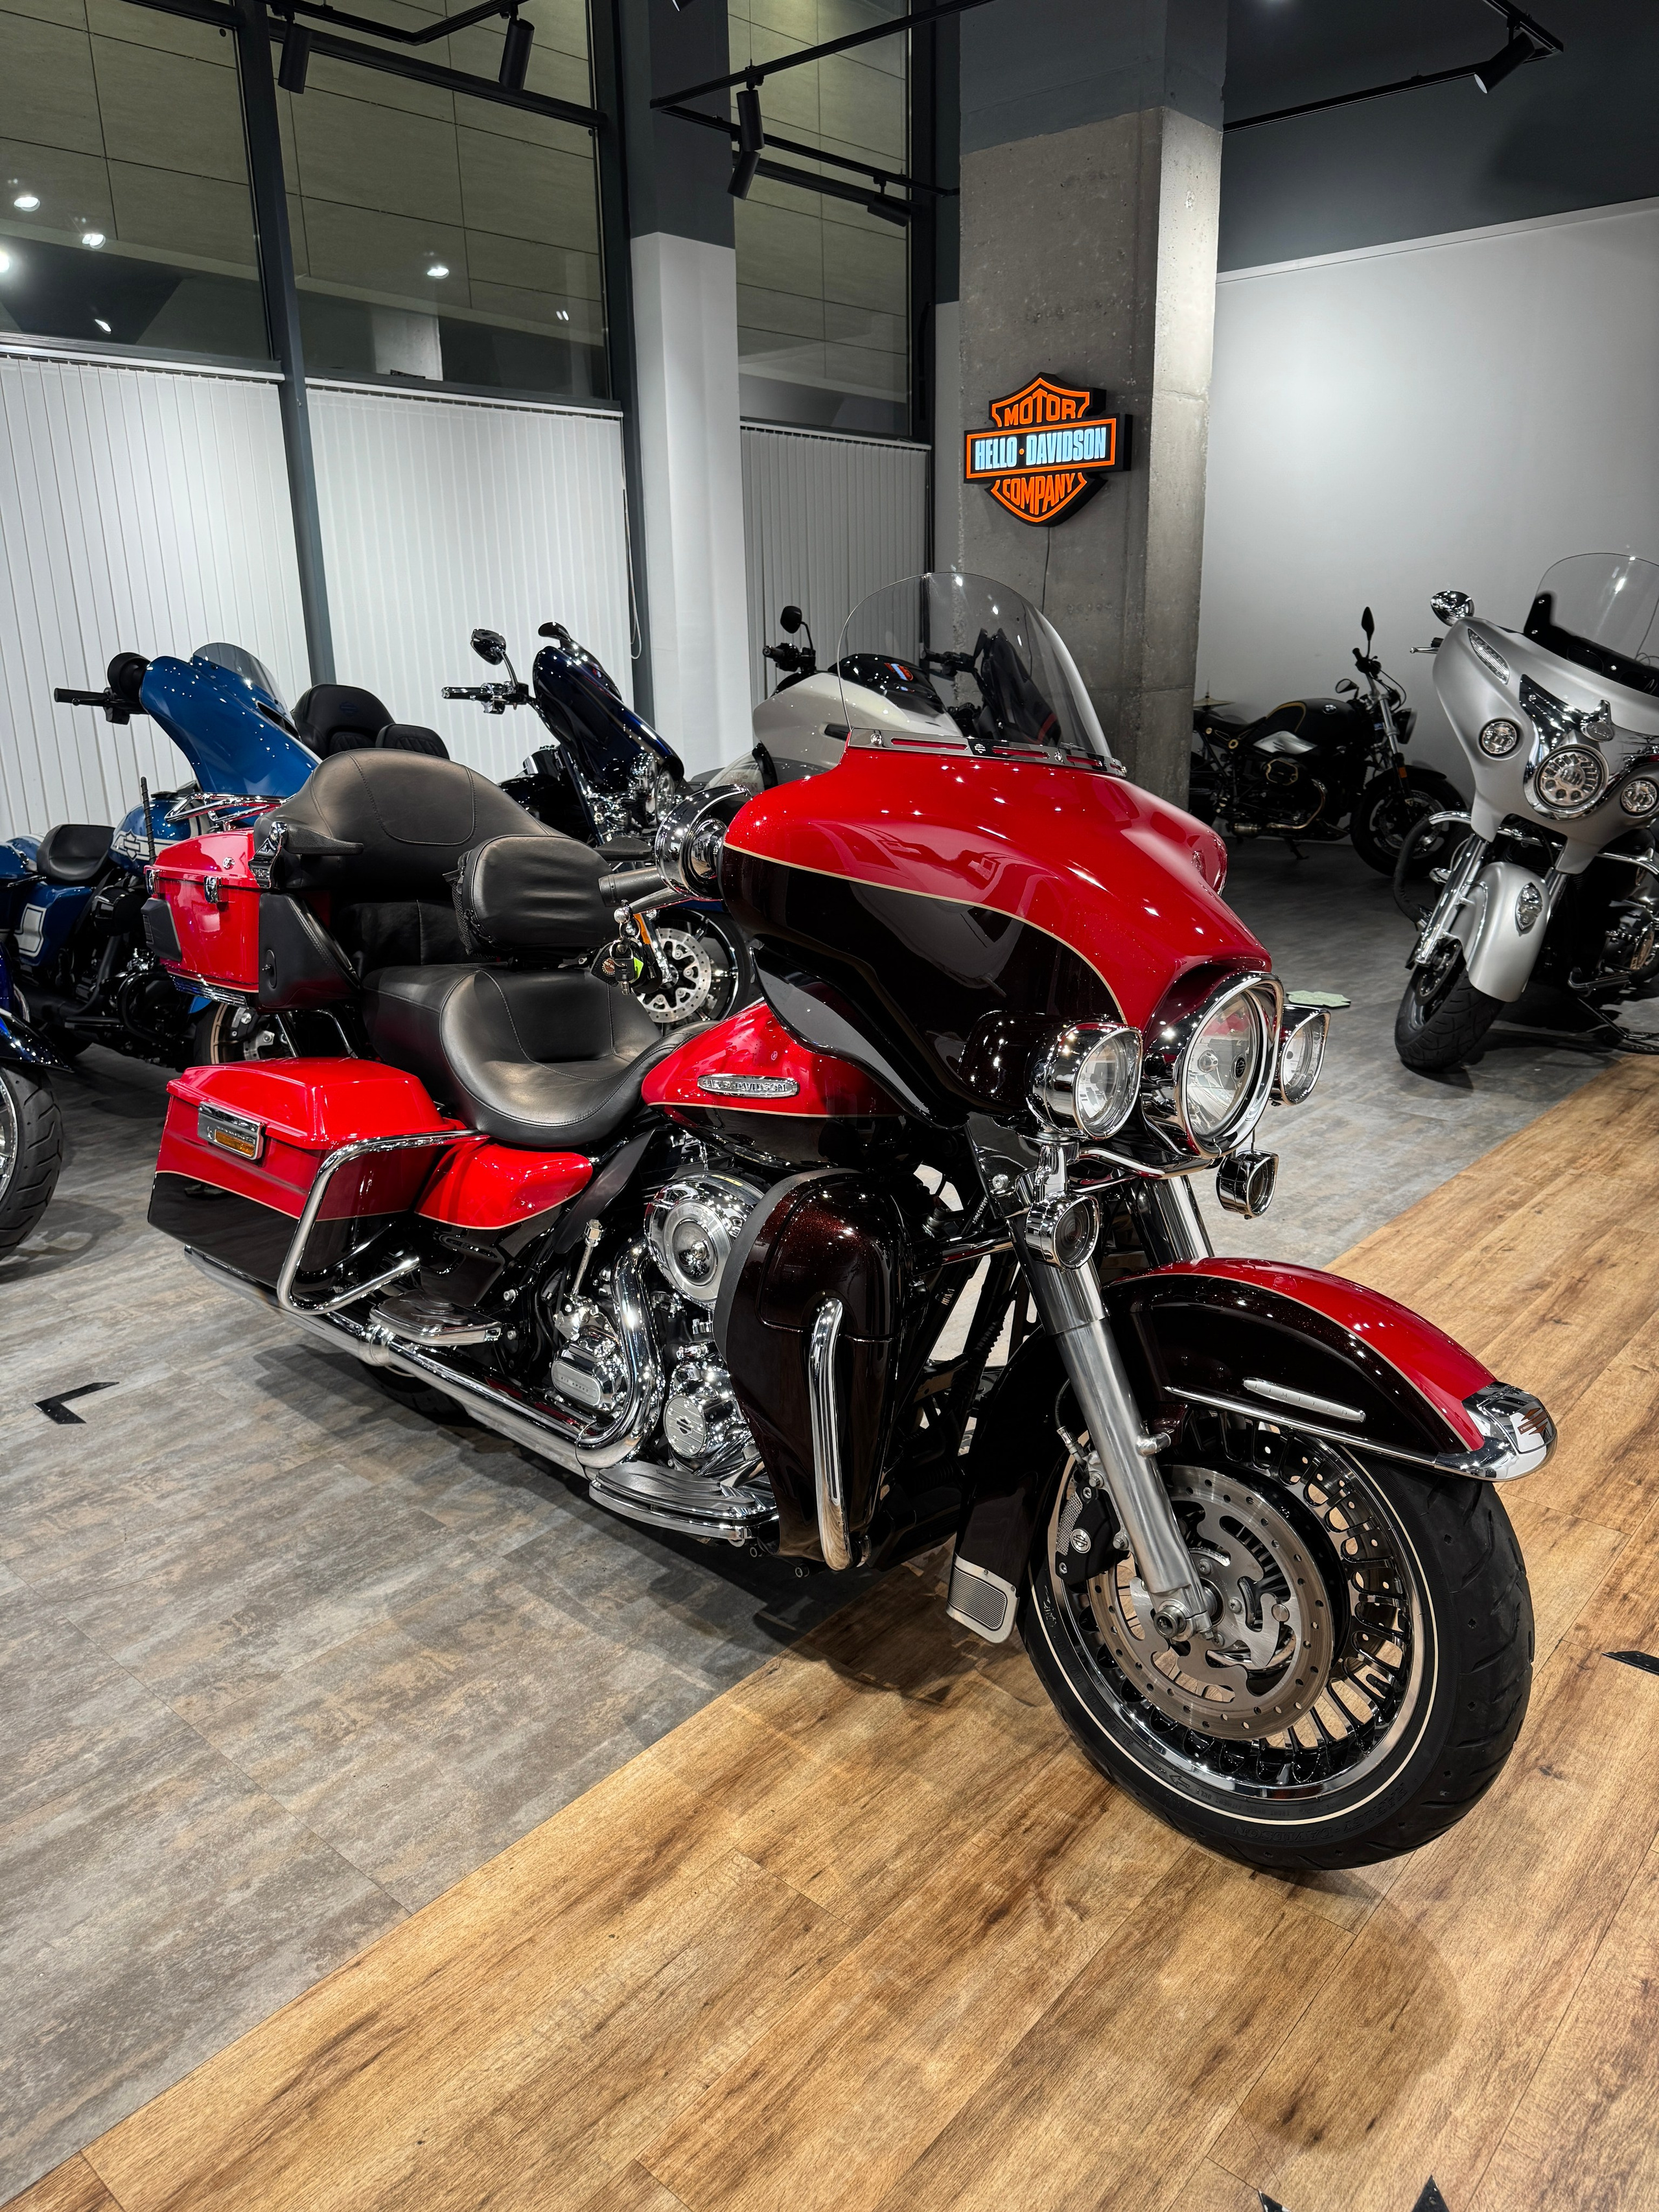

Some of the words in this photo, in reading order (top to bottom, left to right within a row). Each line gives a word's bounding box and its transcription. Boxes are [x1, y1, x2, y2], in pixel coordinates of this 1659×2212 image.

[1004, 388, 1076, 426] MOTOR
[975, 437, 1017, 471] HELLO
[1026, 427, 1107, 466] DAVIDSON
[1003, 472, 1076, 515] COMPANY
[1255, 1384, 1347, 1417] LIMITED
